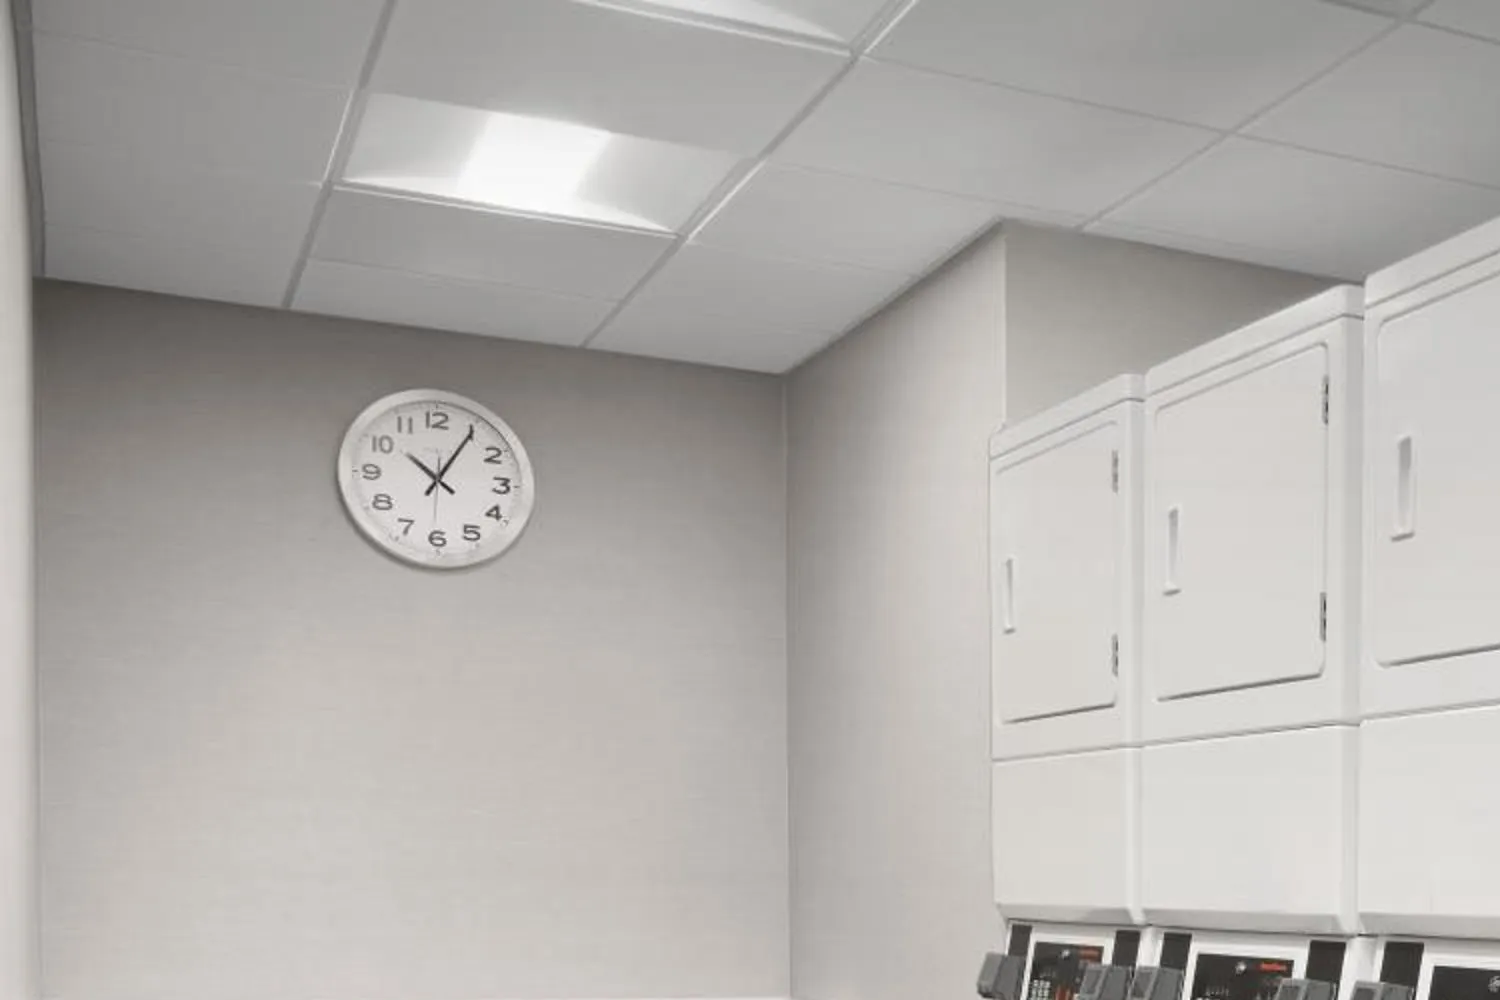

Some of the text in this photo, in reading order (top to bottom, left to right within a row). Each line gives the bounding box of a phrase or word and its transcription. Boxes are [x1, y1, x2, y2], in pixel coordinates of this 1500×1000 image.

[397, 416, 413, 434] 11
[425, 411, 450, 430] 12
[371, 435, 394, 454] 10
[483, 446, 503, 464] 2
[361, 463, 382, 480] 9
[492, 476, 511, 494] 3
[371, 493, 393, 511] 8
[484, 504, 502, 521] 4
[397, 517, 415, 536] 7
[462, 523, 481, 541] 5
[427, 529, 447, 547] 6
